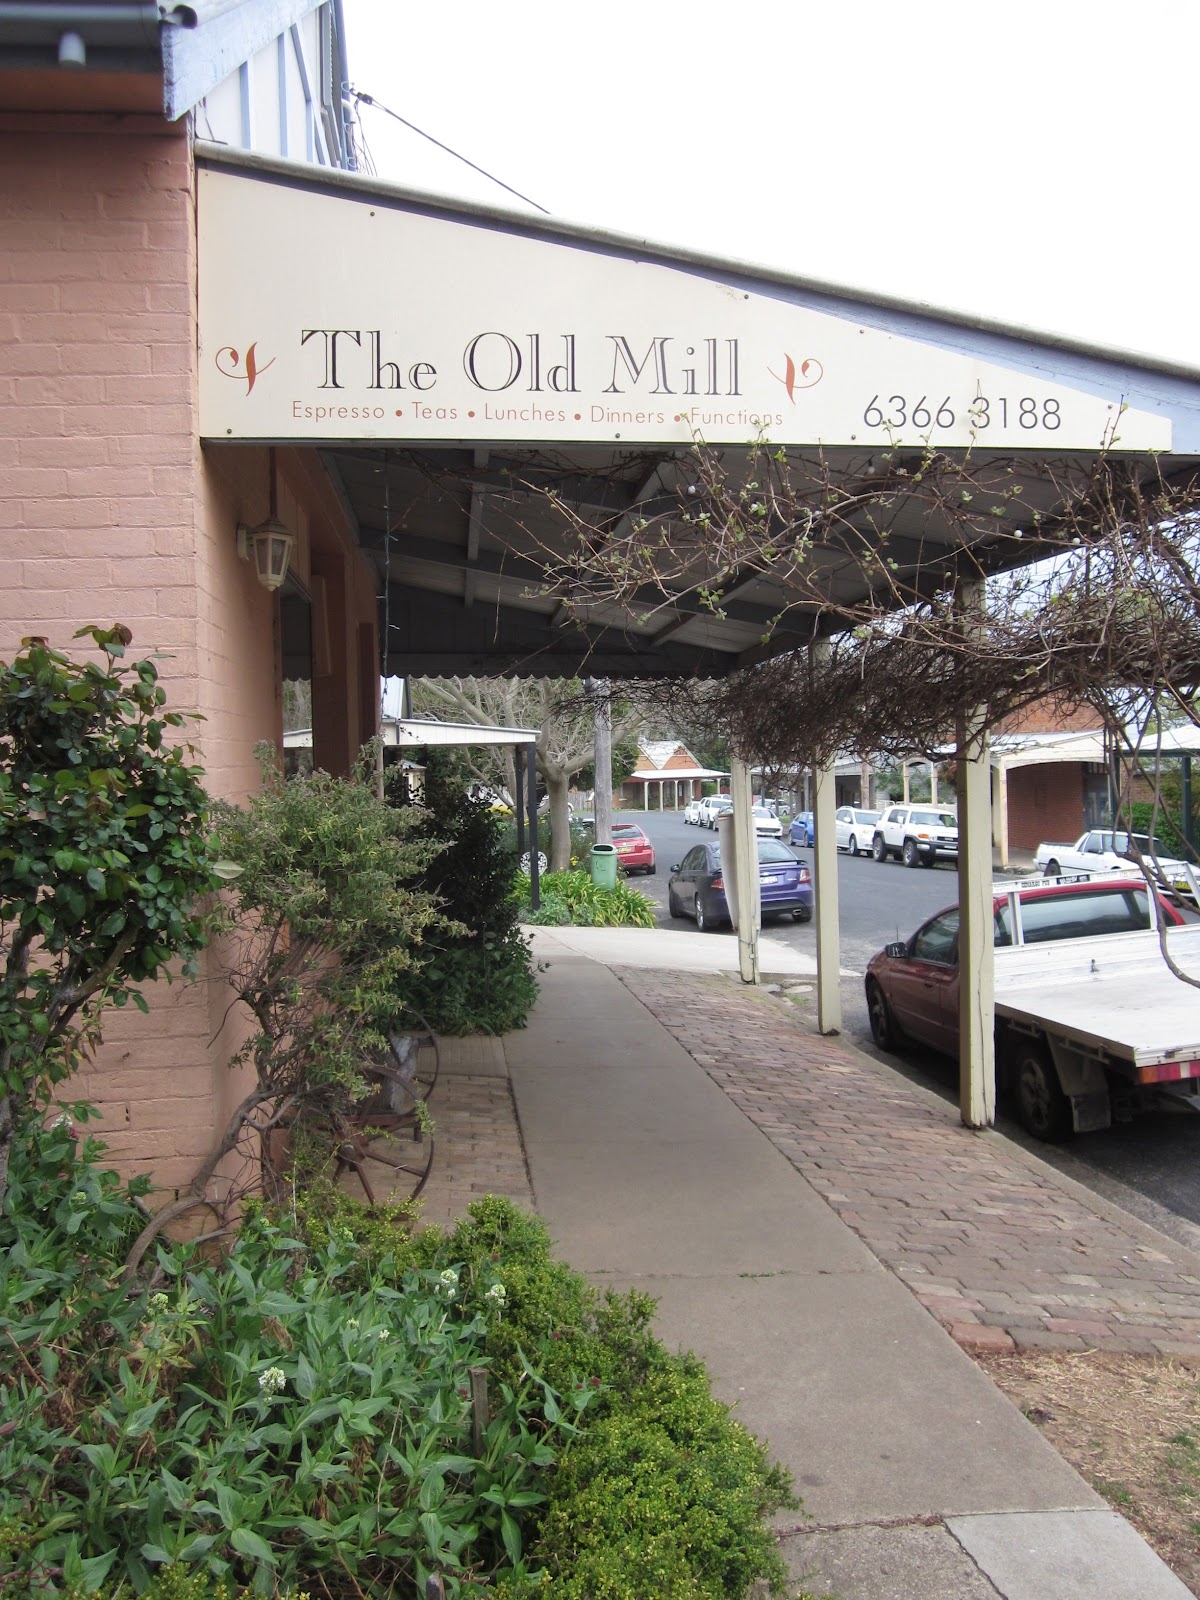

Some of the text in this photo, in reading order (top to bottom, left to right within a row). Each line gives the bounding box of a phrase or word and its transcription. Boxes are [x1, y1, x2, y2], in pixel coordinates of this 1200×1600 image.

[301, 330, 743, 396] The Old Mill
[292, 401, 783, 425] Espresso Teas Lunches Dinners Functions
[864, 395, 1061, 430] 6366 3188
